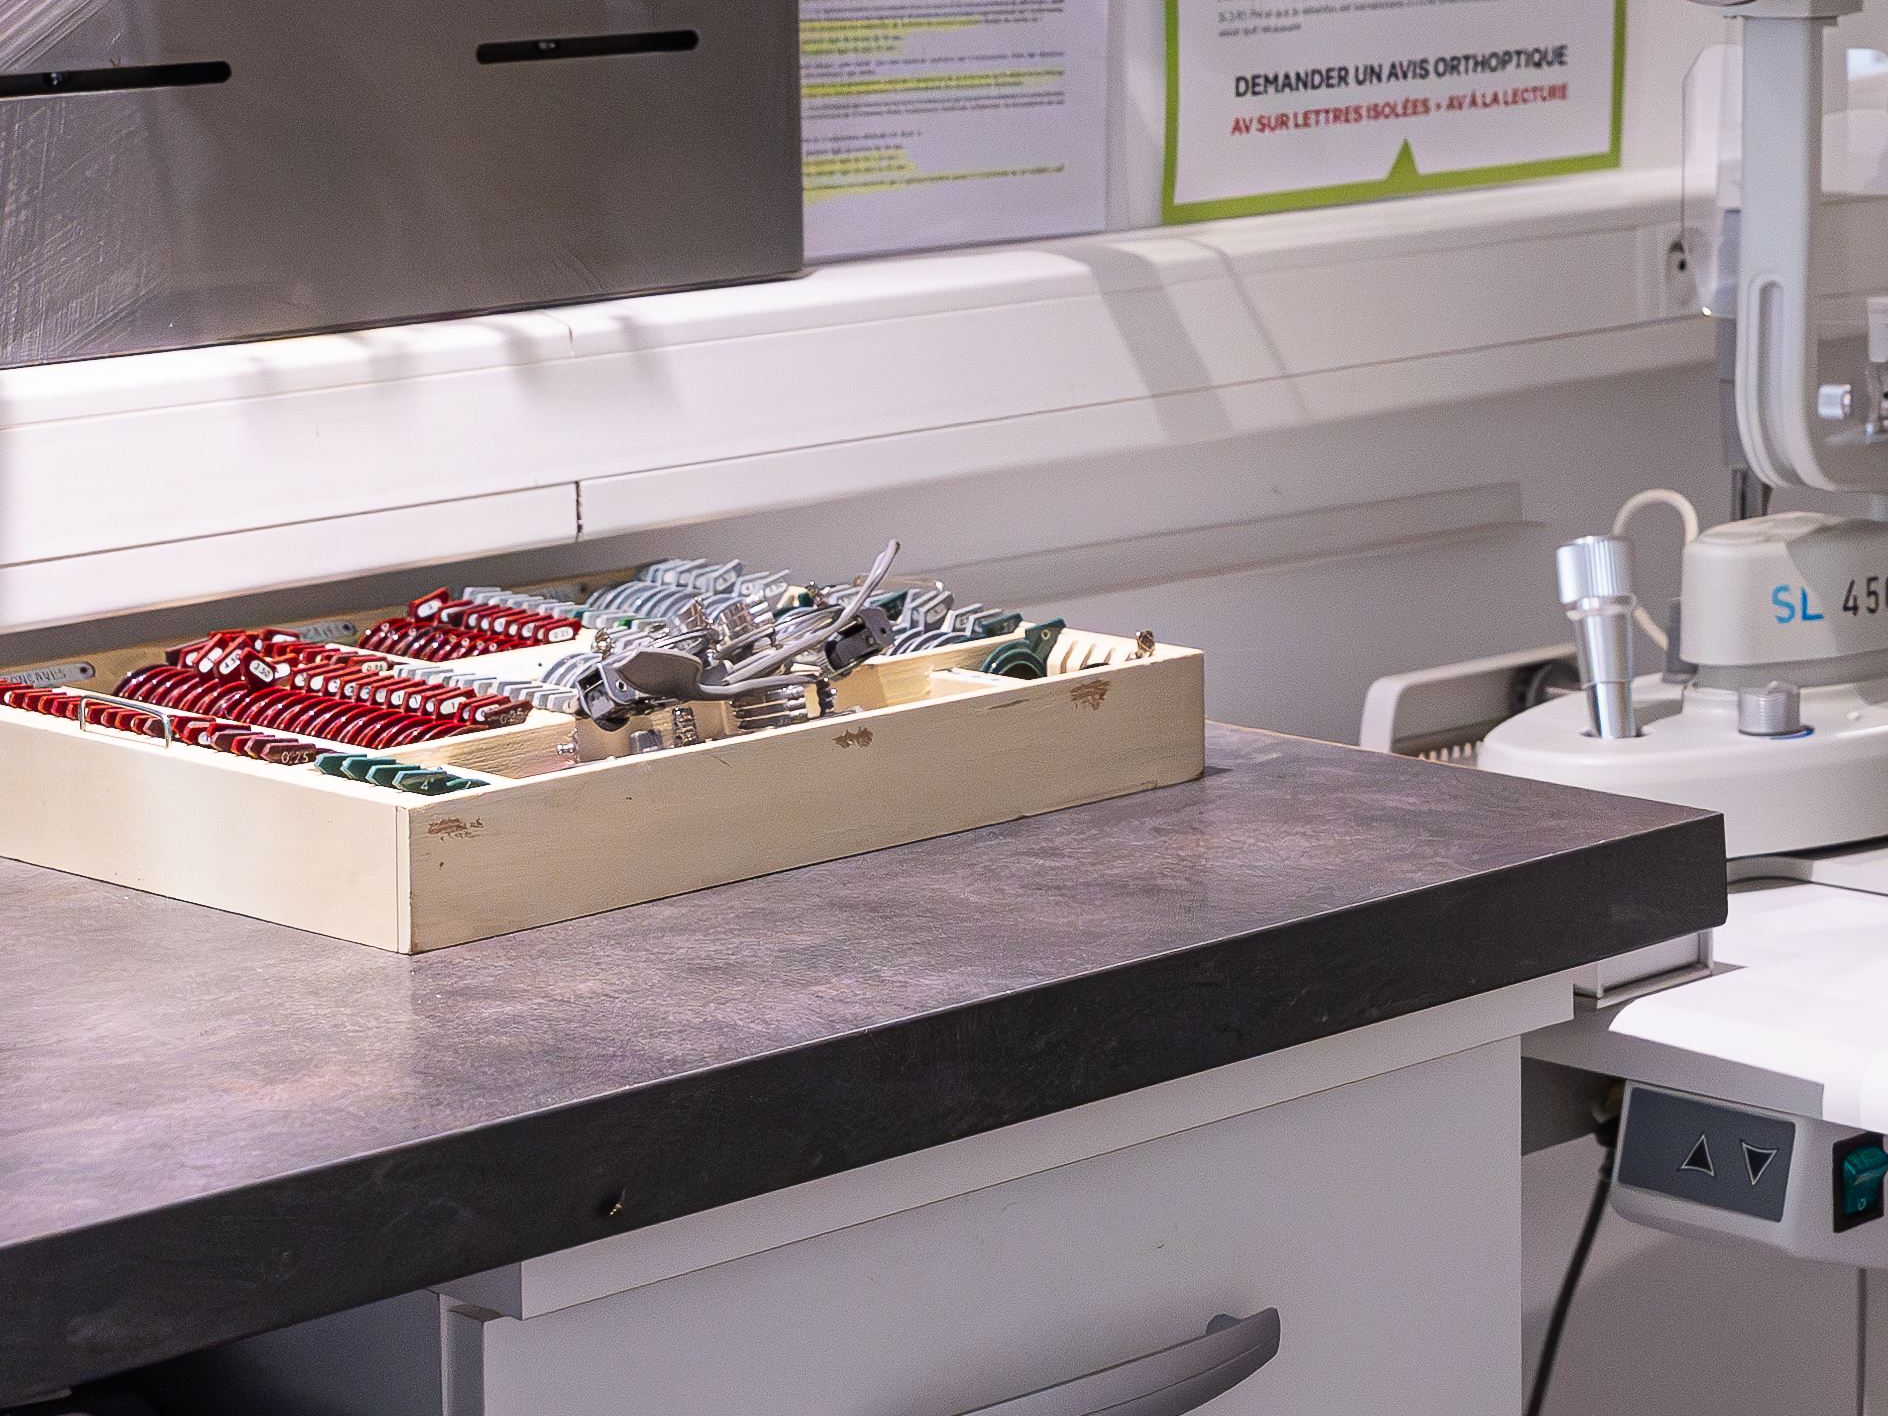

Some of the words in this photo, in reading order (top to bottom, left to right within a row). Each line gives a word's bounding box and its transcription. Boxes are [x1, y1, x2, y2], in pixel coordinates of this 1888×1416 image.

[1234, 66, 1350, 99] DEMANDER
[1354, 63, 1384, 87] UN
[1386, 57, 1430, 84] AVIS
[1433, 45, 1569, 80] ORTHOPTIQUE
[1230, 115, 1254, 136] AV
[1256, 110, 1291, 134] SUR
[1293, 103, 1363, 131] LETTRES
[1366, 95, 1431, 123] ISOLÉES
[1446, 93, 1468, 112] AV
[1482, 90, 1501, 107] LA
[1503, 82, 1569, 106] LECTURE
[1771, 583, 1824, 623] SL
